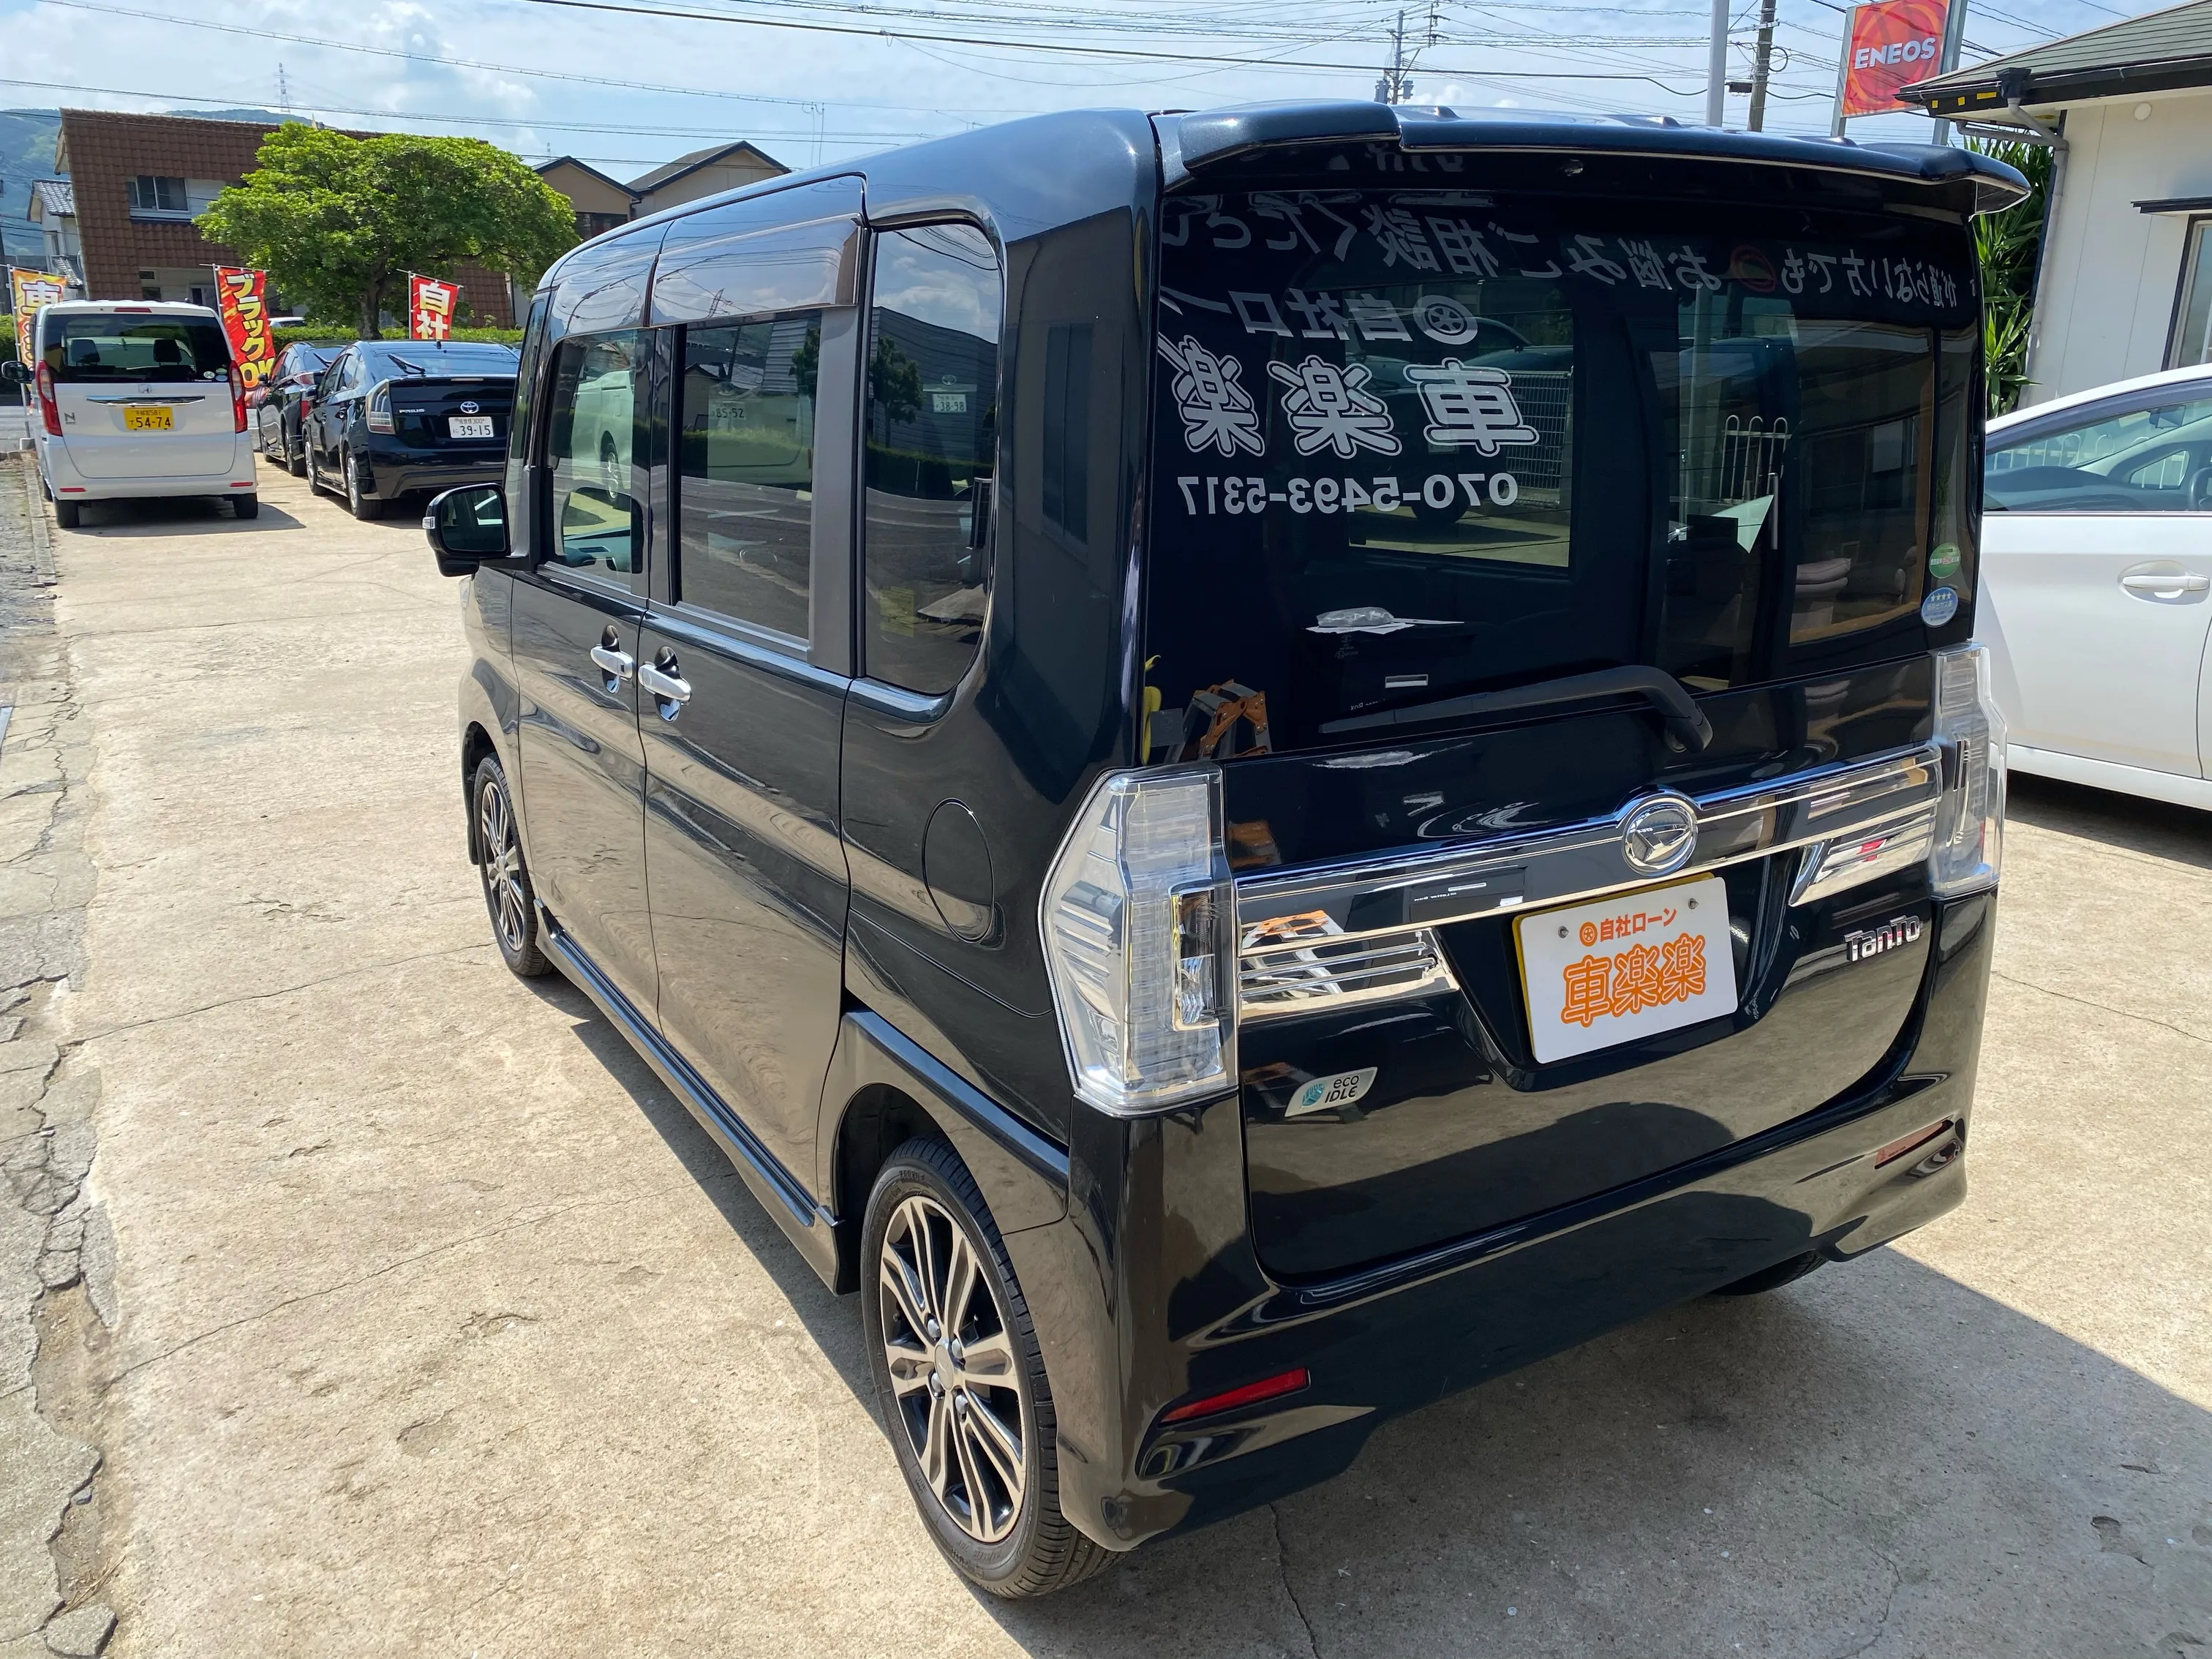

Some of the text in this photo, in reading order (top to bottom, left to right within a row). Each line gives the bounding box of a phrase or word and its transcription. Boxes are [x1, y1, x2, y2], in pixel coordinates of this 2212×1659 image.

[1854, 37, 1936, 69] ENEOS
[415, 282, 451, 339] 自社
[136, 417, 170, 428] 54-74
[459, 425, 491, 436] 39-15
[1600, 908, 1677, 942] 自社ローン
[1560, 933, 1706, 1028] 車楽楽
[1333, 1075, 1359, 1088] eco
[1325, 1086, 1358, 1103] IDLE
